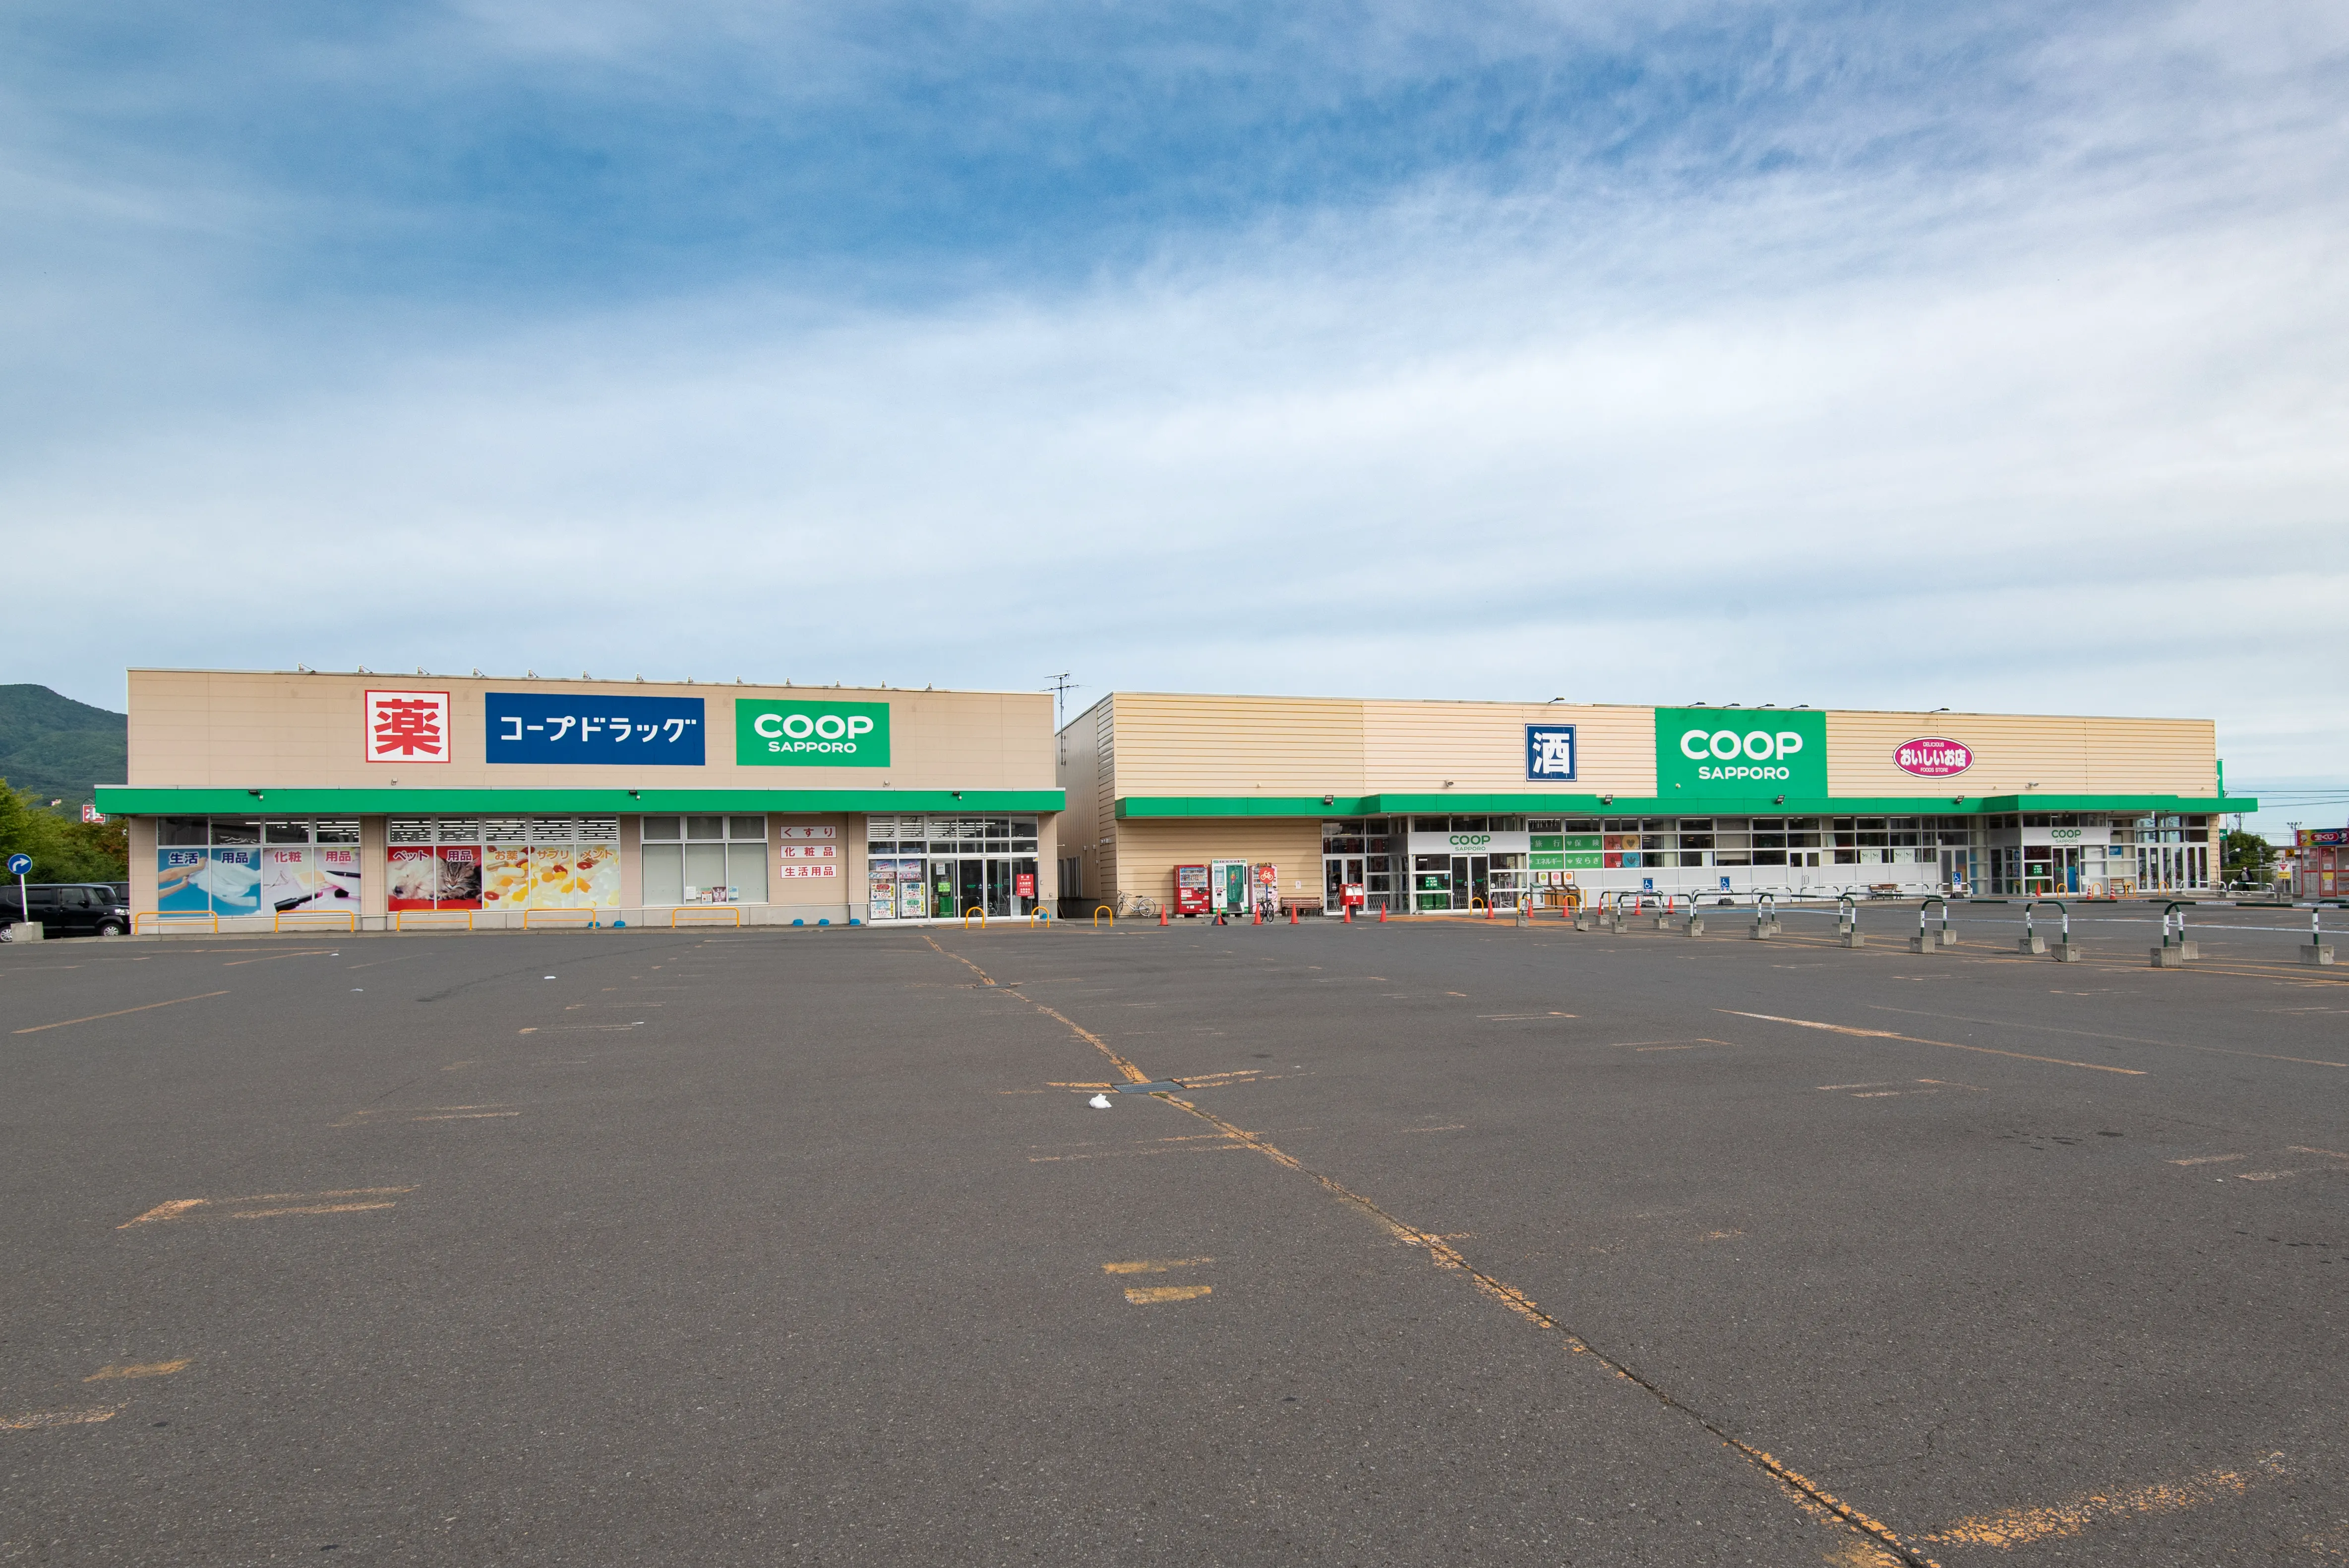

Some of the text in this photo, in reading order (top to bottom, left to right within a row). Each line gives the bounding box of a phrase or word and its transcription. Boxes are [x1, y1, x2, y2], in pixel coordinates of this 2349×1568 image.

[374, 698, 442, 756] 薬
[500, 715, 697, 743] コープドラッグ
[754, 713, 874, 739] COOP
[768, 741, 857, 753] SAPPORO
[1680, 729, 1803, 761] COOP
[1532, 731, 1570, 776] 酒
[1900, 748, 1966, 767] おいしいお店
[1698, 766, 1790, 781] SAPPORO
[784, 828, 833, 837] くすり
[2051, 829, 2081, 838] COOP
[1449, 835, 1491, 845] COOP
[1535, 839, 1561, 847] 旅行
[393, 849, 473, 862] ペット 用品
[494, 850, 518, 861] お薬
[537, 849, 613, 860] サプリ メント
[784, 847, 833, 857] 化粧品
[785, 867, 833, 876] 生活用品
